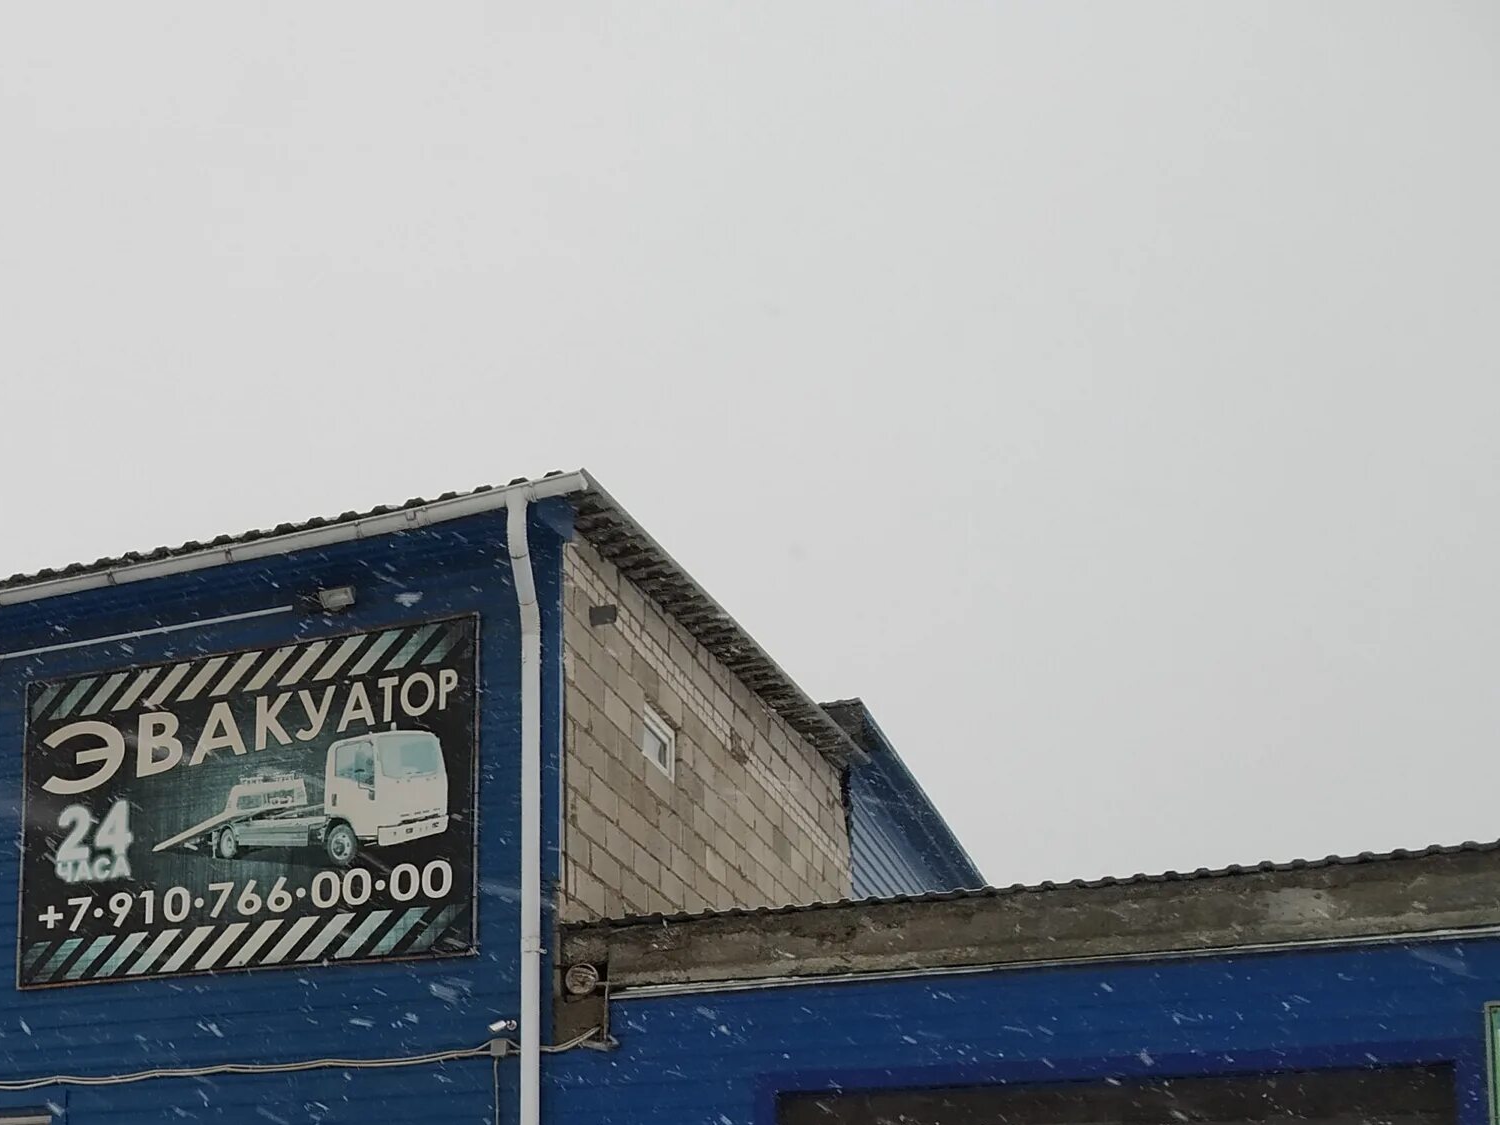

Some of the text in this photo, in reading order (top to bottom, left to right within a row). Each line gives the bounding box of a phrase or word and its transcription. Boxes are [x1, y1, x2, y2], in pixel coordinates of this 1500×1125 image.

[41, 668, 459, 795] ЭВАКУАТОР
[56, 799, 133, 861] 24
[56, 855, 132, 883] ЧАСА
